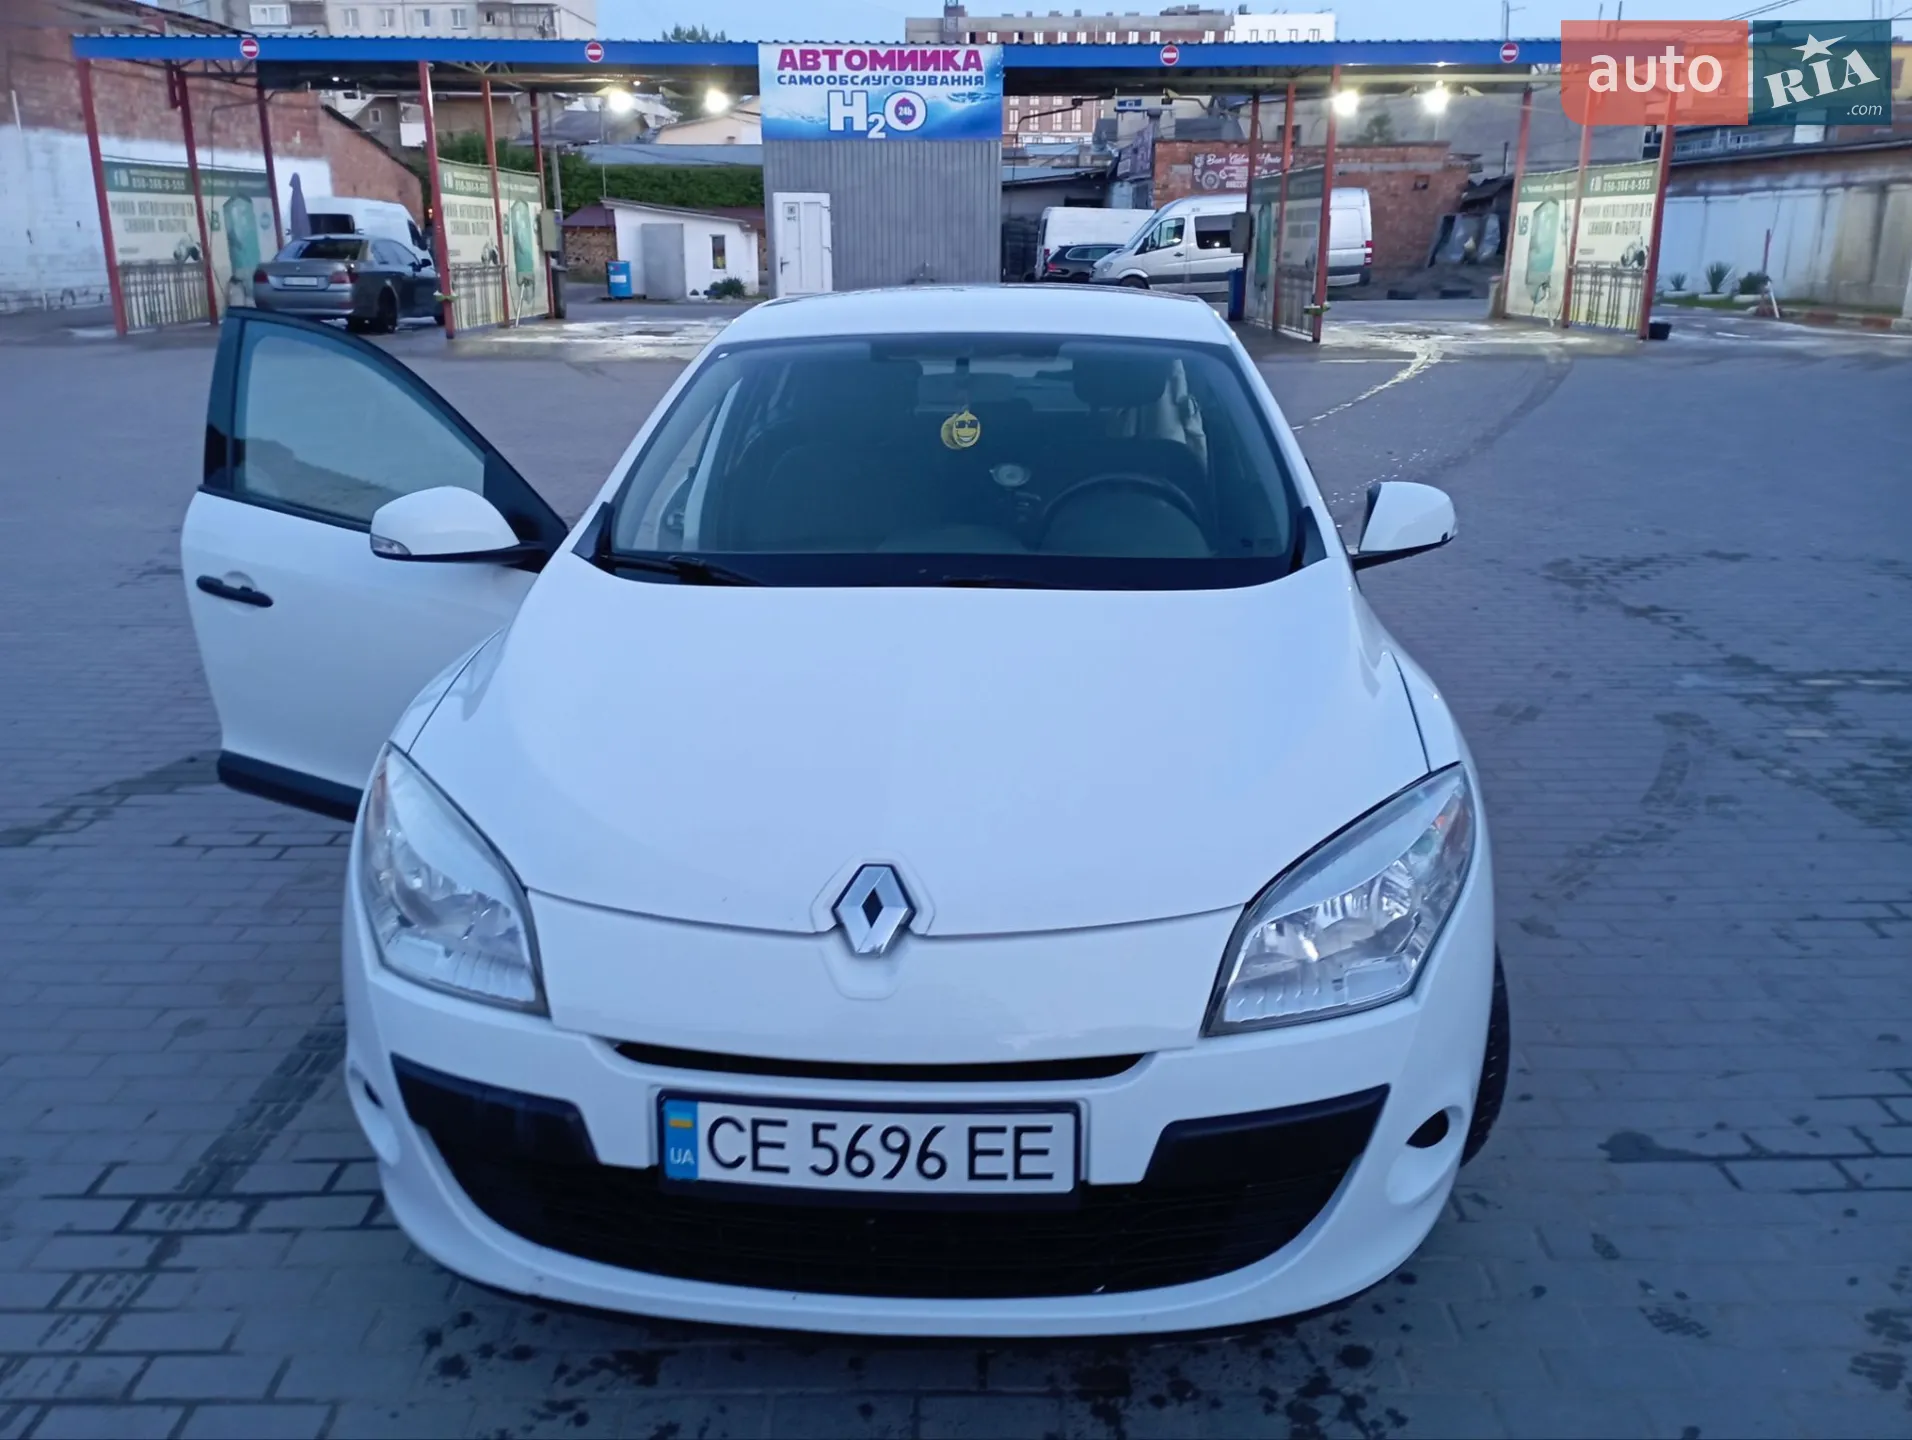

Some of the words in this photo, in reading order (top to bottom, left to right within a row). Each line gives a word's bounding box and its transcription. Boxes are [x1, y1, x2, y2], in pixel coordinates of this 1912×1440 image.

[777, 74, 985, 86] САМООБСЛУГОВУВАННЯ
[670, 1146, 695, 1165] UA
[706, 1116, 790, 1174] CE
[809, 1122, 949, 1180] 5696
[967, 1125, 1054, 1181] EE
